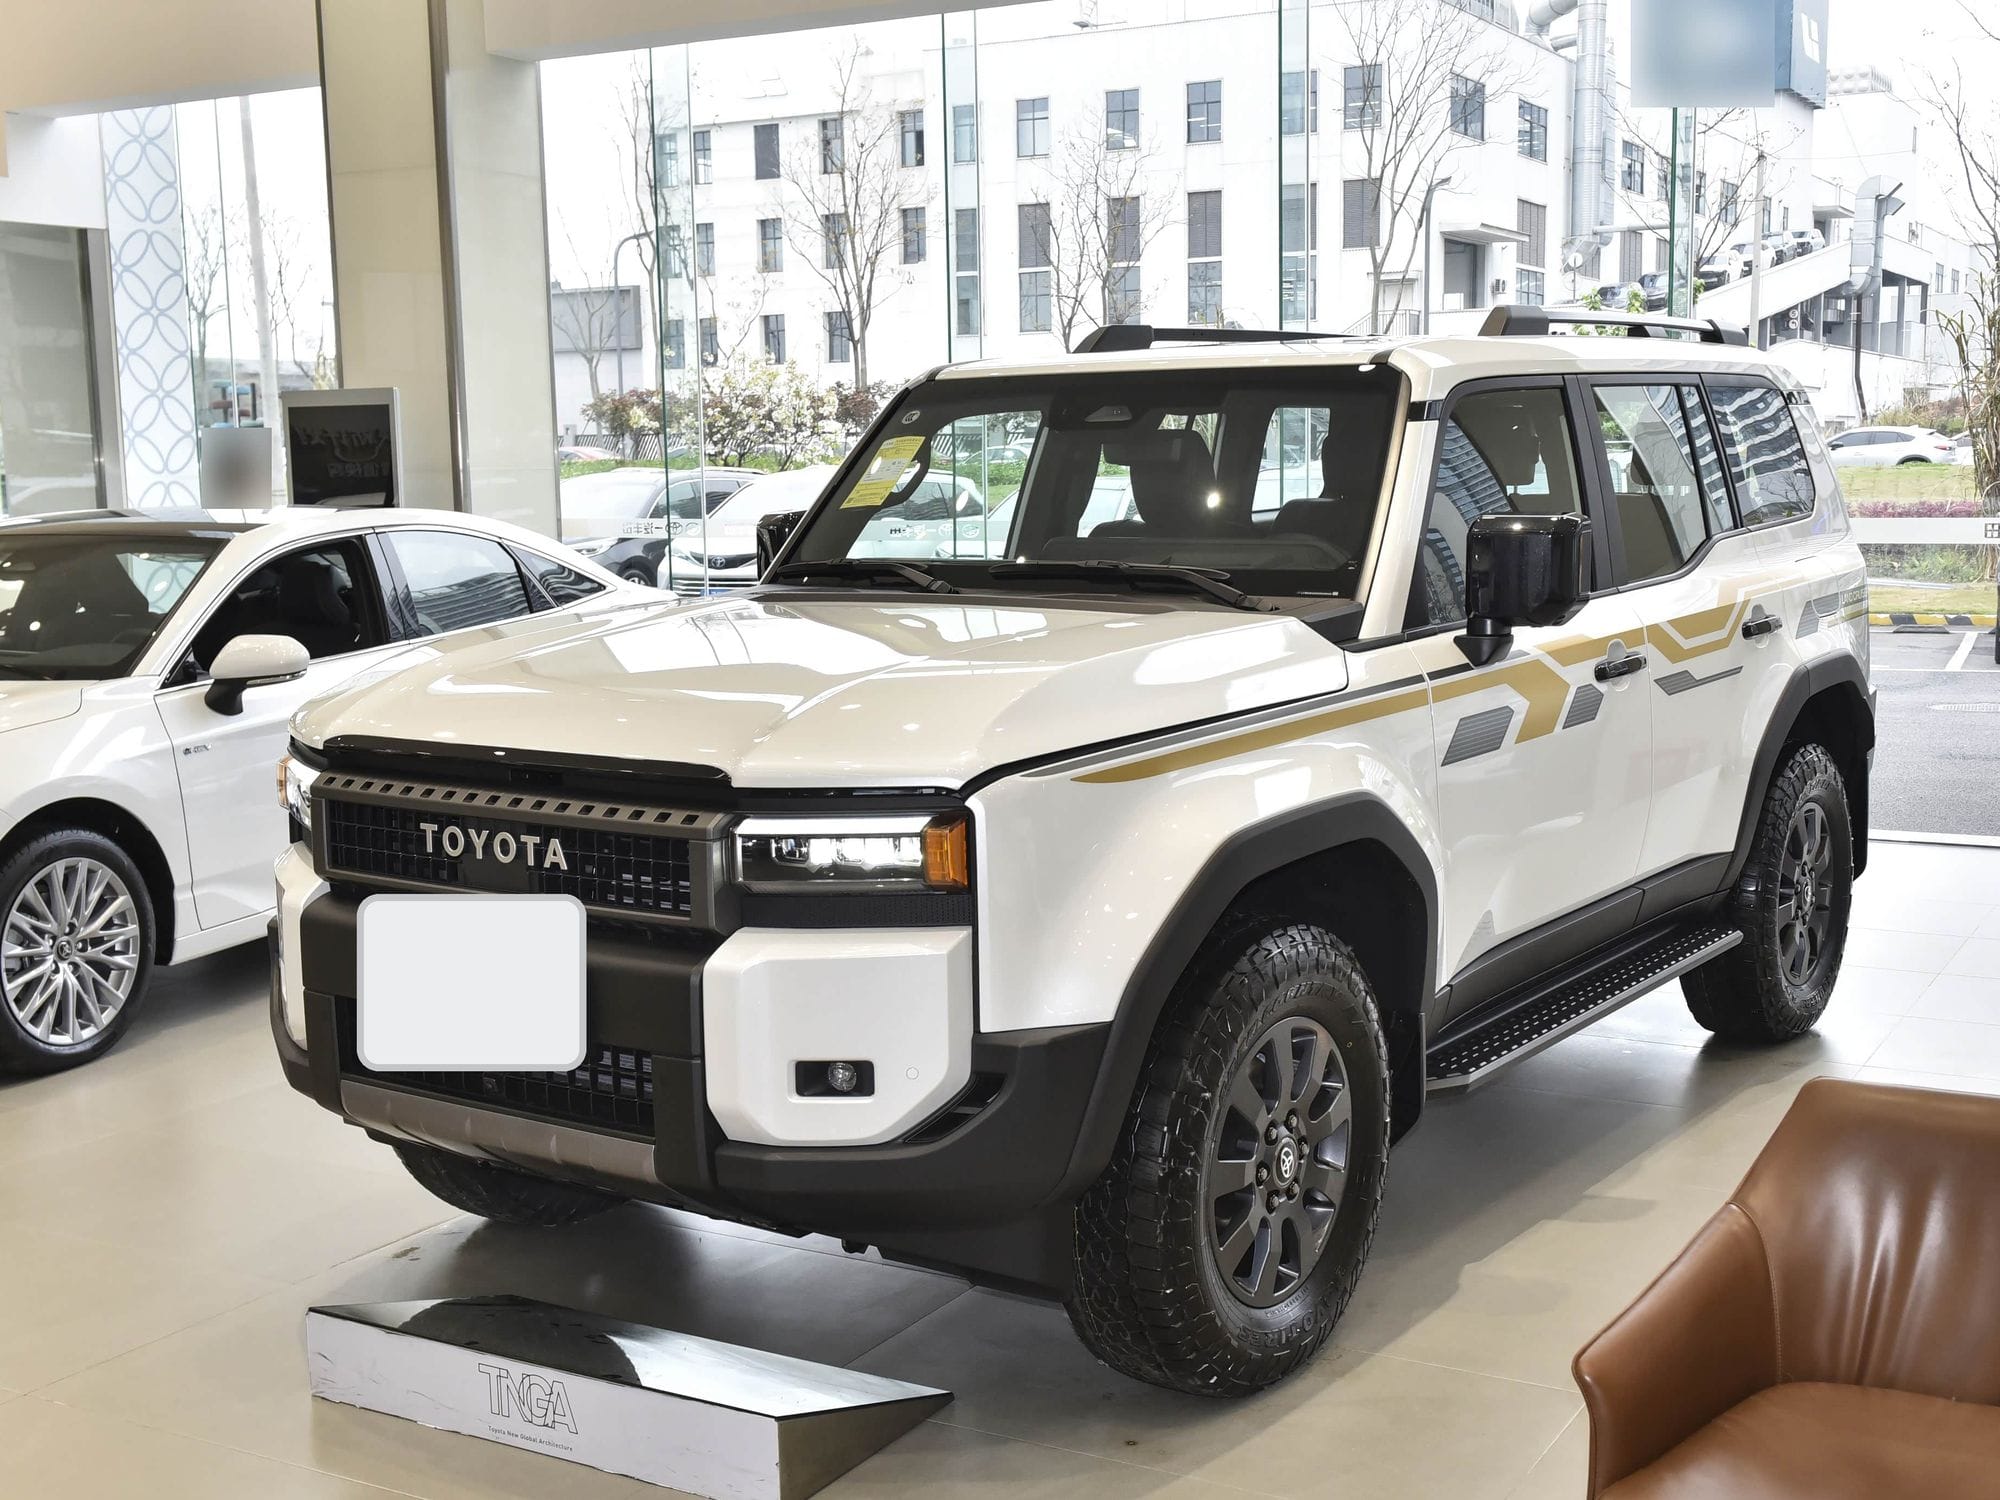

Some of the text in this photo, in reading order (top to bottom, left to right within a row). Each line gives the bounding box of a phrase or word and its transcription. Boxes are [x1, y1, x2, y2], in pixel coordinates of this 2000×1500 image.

[419, 822, 568, 870] TOYOTA
[478, 1362, 579, 1435] TNGA
[488, 1425, 574, 1452] Toyota New Global Architecture
